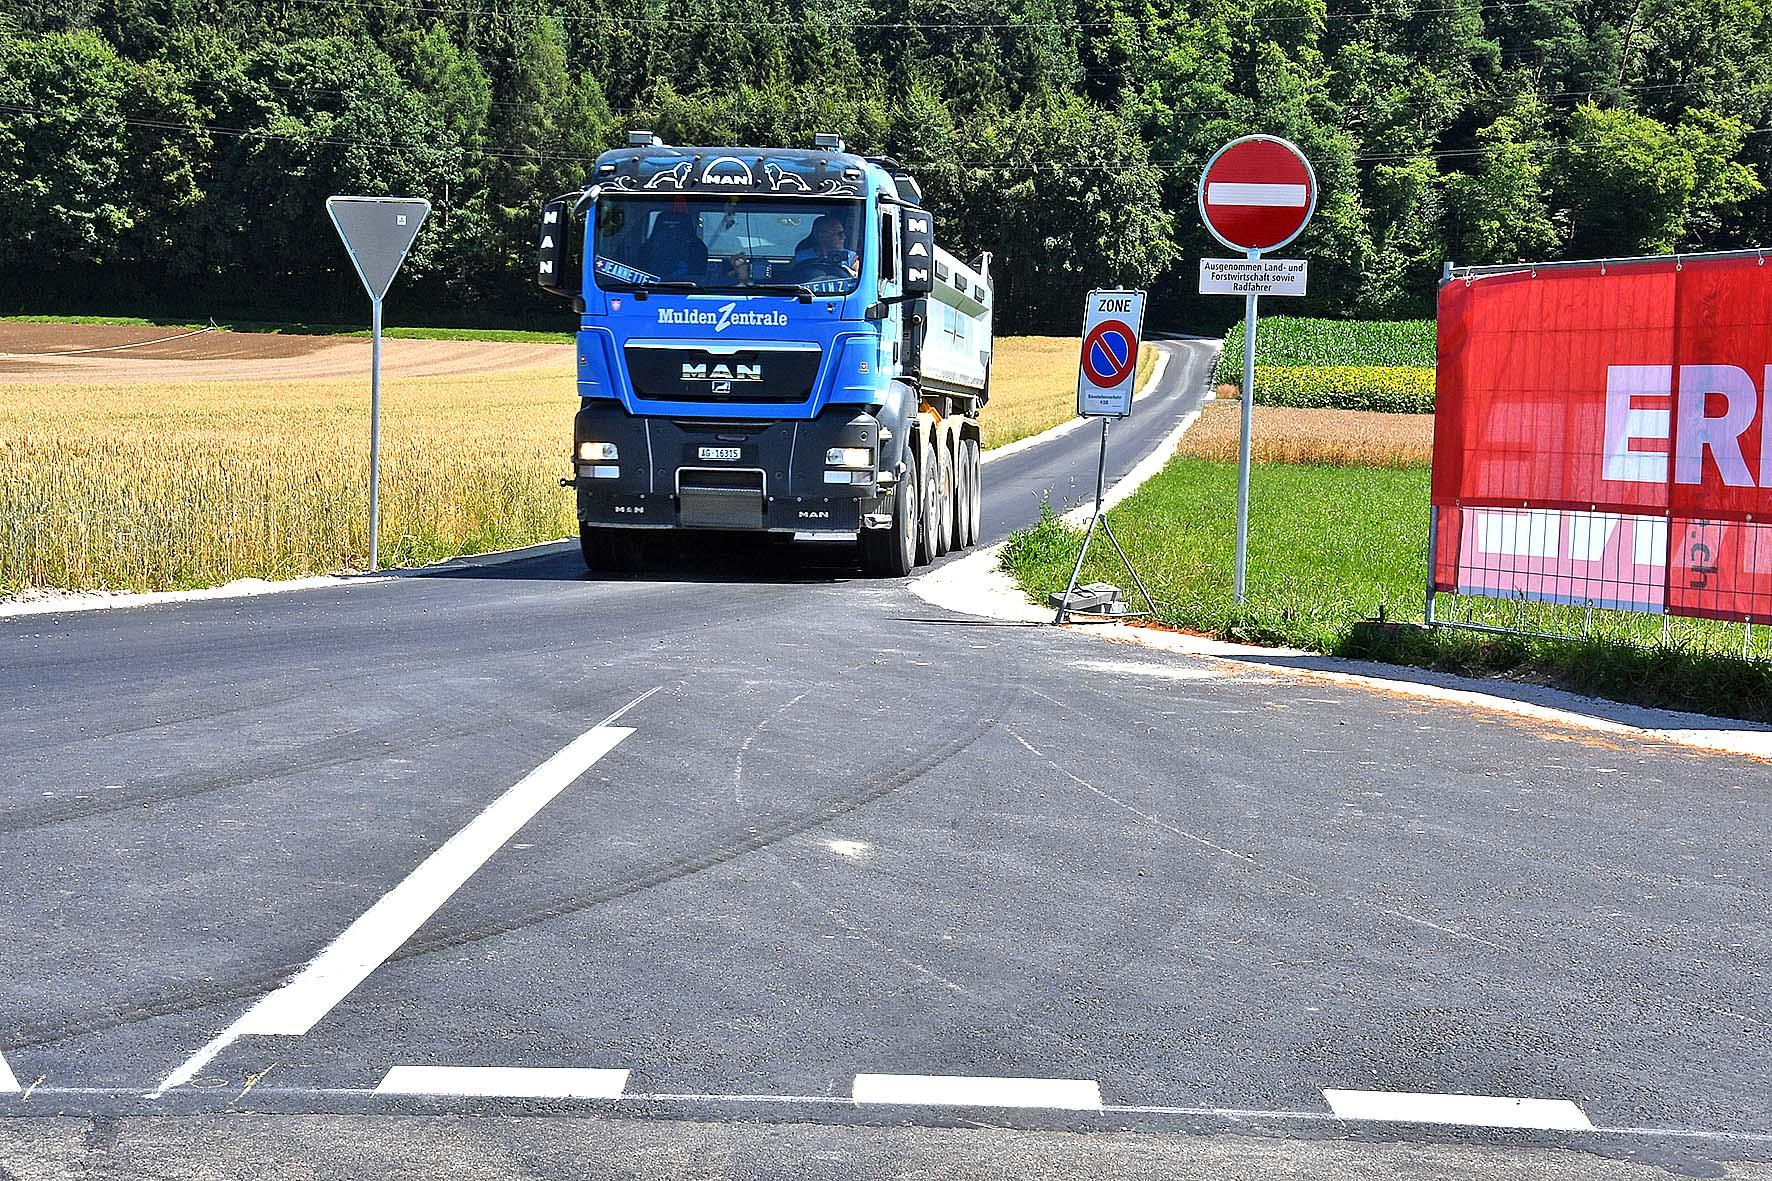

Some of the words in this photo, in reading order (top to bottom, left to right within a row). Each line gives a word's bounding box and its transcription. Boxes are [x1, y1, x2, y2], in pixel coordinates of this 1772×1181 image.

[706, 175, 748, 185] MAN
[540, 211, 558, 274] MAN
[908, 218, 928, 282] MAN
[602, 261, 650, 284] JEANNETTE
[1204, 262, 1261, 272] Ausgenommen
[1264, 263, 1286, 271] Land-
[1288, 264, 1304, 272] und
[1211, 272, 1270, 282] Forstwirtschaft
[1272, 274, 1295, 282] sowie
[804, 281, 845, 293] EINZ
[1233, 283, 1272, 292] Radfahrer
[1098, 299, 1132, 312] ZONE
[682, 363, 762, 380] MAN
[1602, 364, 1772, 489] ER
[615, 506, 645, 514] MAN
